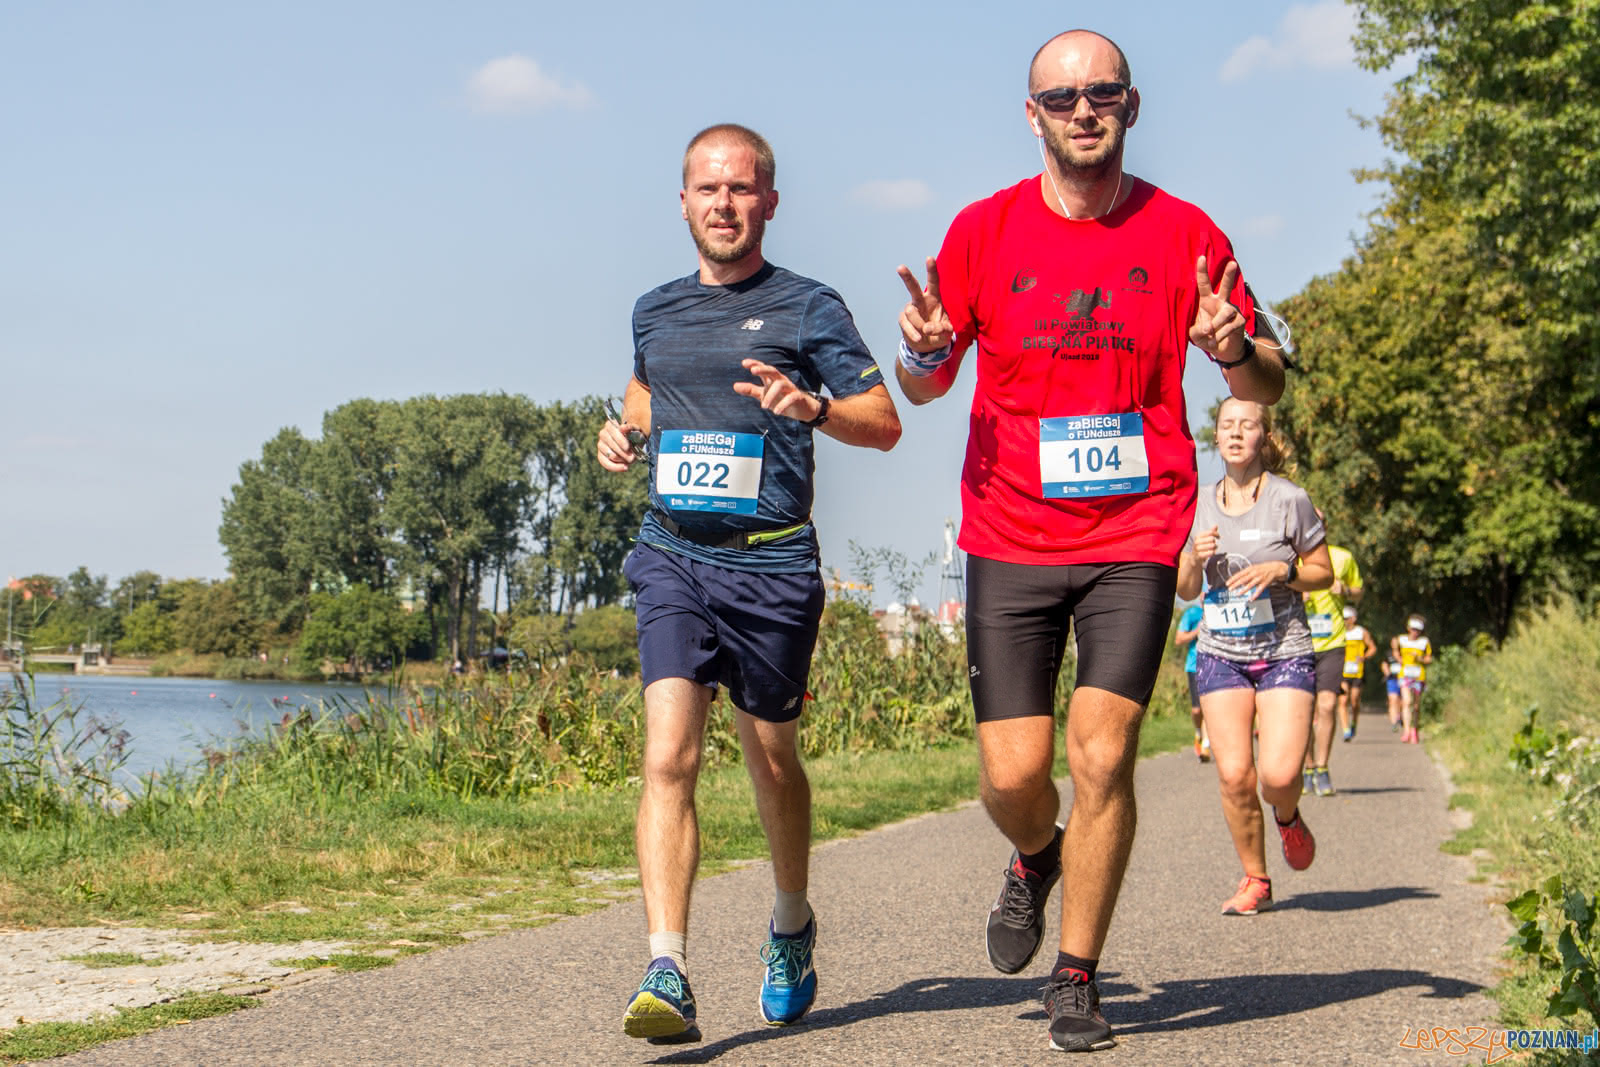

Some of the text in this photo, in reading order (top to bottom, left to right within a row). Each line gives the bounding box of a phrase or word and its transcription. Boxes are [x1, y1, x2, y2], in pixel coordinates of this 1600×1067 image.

[1034, 318, 1125, 334] III Powiatowy
[1022, 335, 1136, 354] BIEG NA PIĄTKĘ
[1067, 416, 1121, 430] zaBIEGaj
[681, 432, 736, 449] zaBIEGaj
[1068, 429, 1121, 440] o FUNdusze
[681, 444, 735, 455] o FUNdusze
[1067, 445, 1122, 474] 104
[677, 461, 730, 489] 022
[1220, 605, 1253, 623] 114
